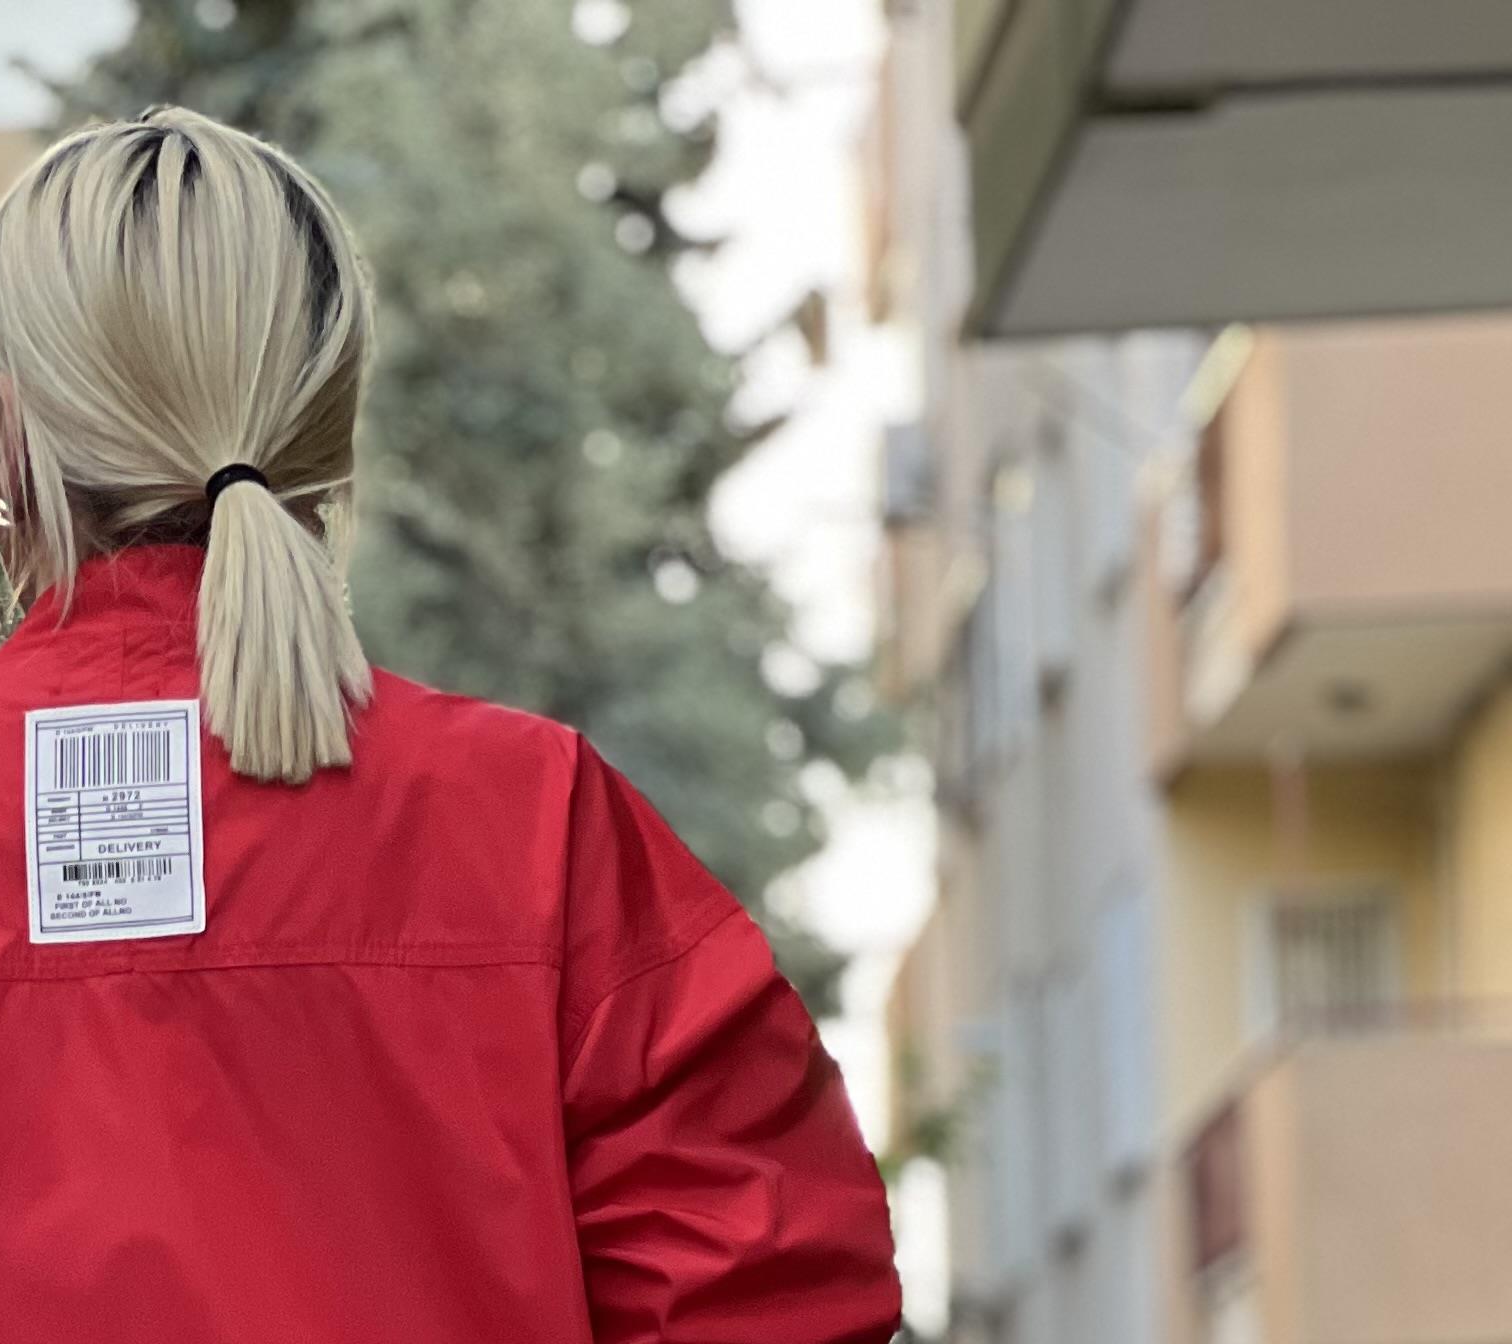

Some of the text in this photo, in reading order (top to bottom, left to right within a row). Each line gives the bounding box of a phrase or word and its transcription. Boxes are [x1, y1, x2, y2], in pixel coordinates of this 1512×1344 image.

[98, 840, 162, 854] DELIVERY
[54, 902, 79, 910] FIRST
[81, 900, 93, 908] OF
[95, 899, 112, 907] ALL
[50, 911, 87, 921] SECOND
[88, 910, 100, 918] OF
